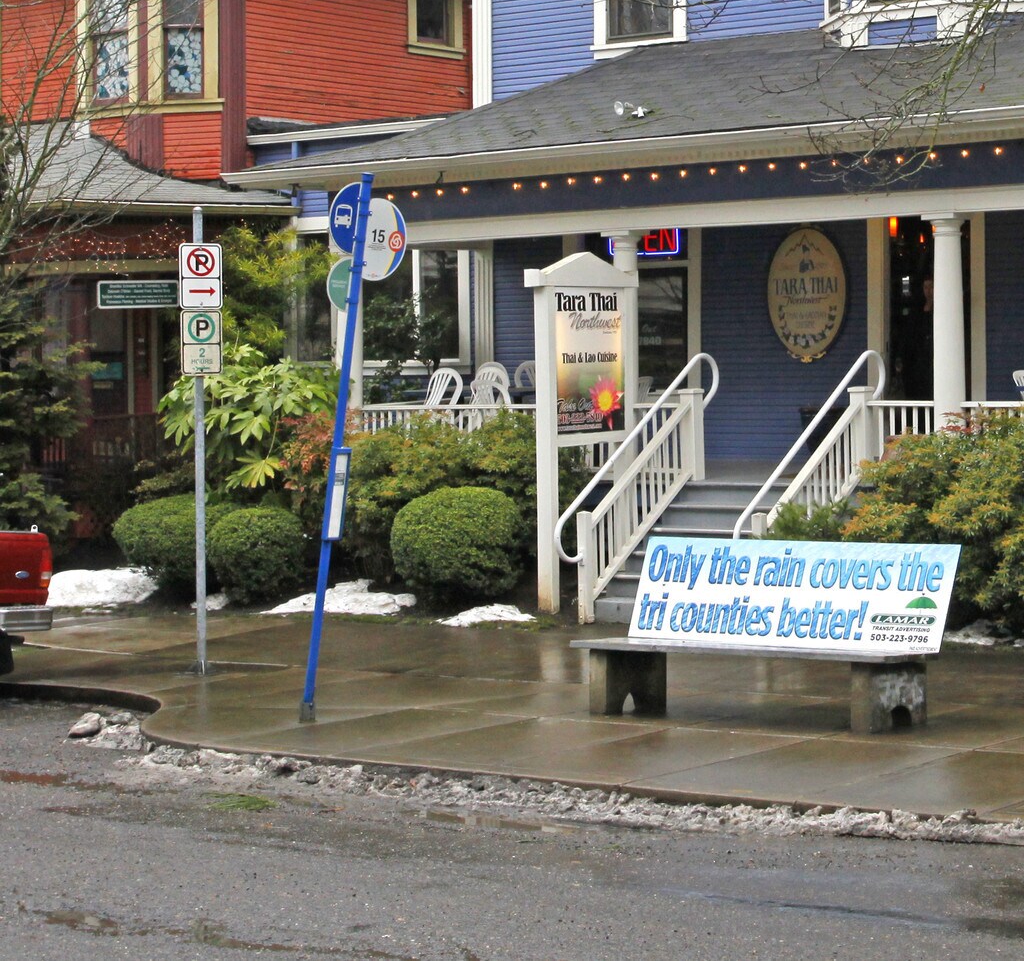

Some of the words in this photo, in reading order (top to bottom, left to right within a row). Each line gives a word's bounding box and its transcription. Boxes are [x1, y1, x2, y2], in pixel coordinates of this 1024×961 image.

[372, 229, 385, 243] 15
[775, 279, 807, 296] TARA
[809, 277, 838, 294] THAI
[554, 292, 586, 312] Tara
[588, 292, 618, 312] Thai
[195, 319, 209, 337] P
[568, 312, 621, 330] Northwest
[198, 348, 206, 358] 2
[562, 352, 577, 364] Thai
[577, 352, 584, 363] &
[584, 352, 596, 363] Lao
[597, 351, 618, 363] Cuisine
[557, 398, 577, 414] Take
[648, 544, 706, 590] Only
[708, 546, 751, 585] the
[753, 547, 806, 588] rain
[809, 557, 894, 591] covers
[897, 551, 945, 592] the
[637, 592, 669, 630] tri
[669, 595, 775, 636] counties
[776, 596, 869, 641] better!
[875, 615, 930, 625] LAMAR
[870, 633, 929, 643] 503-223-9796
